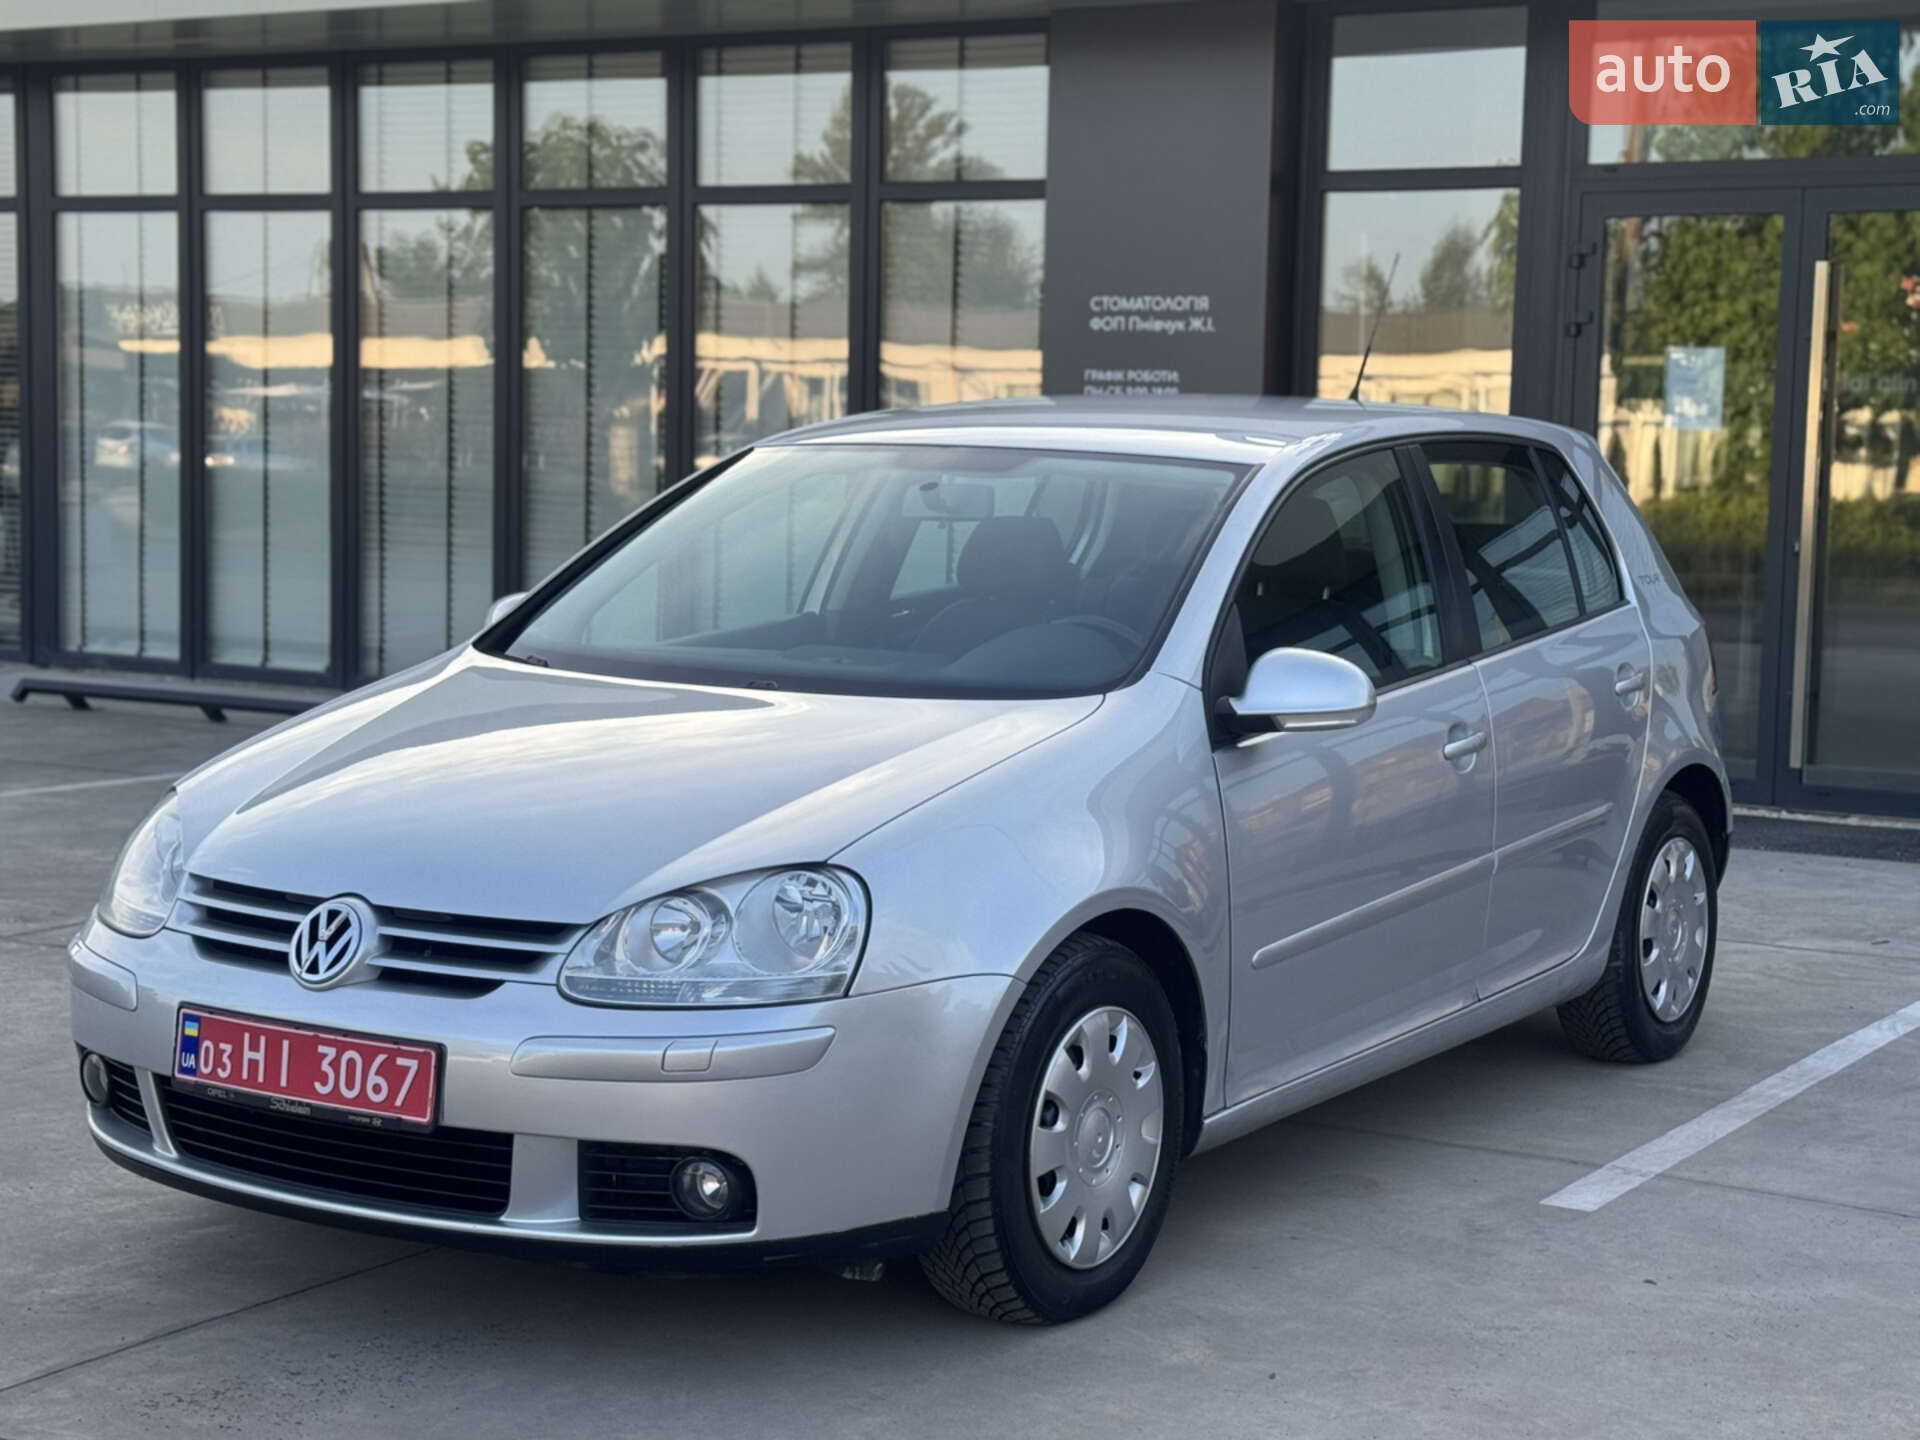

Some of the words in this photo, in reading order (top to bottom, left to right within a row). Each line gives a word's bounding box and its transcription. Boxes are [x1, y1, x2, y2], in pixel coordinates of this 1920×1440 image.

[1089, 295, 1210, 312] СТОМАТОЛОГІЯ
[1089, 315, 1126, 331] ФОП
[181, 1052, 196, 1069] UA
[199, 1040, 232, 1079] 03
[313, 1044, 419, 1108] 3067
